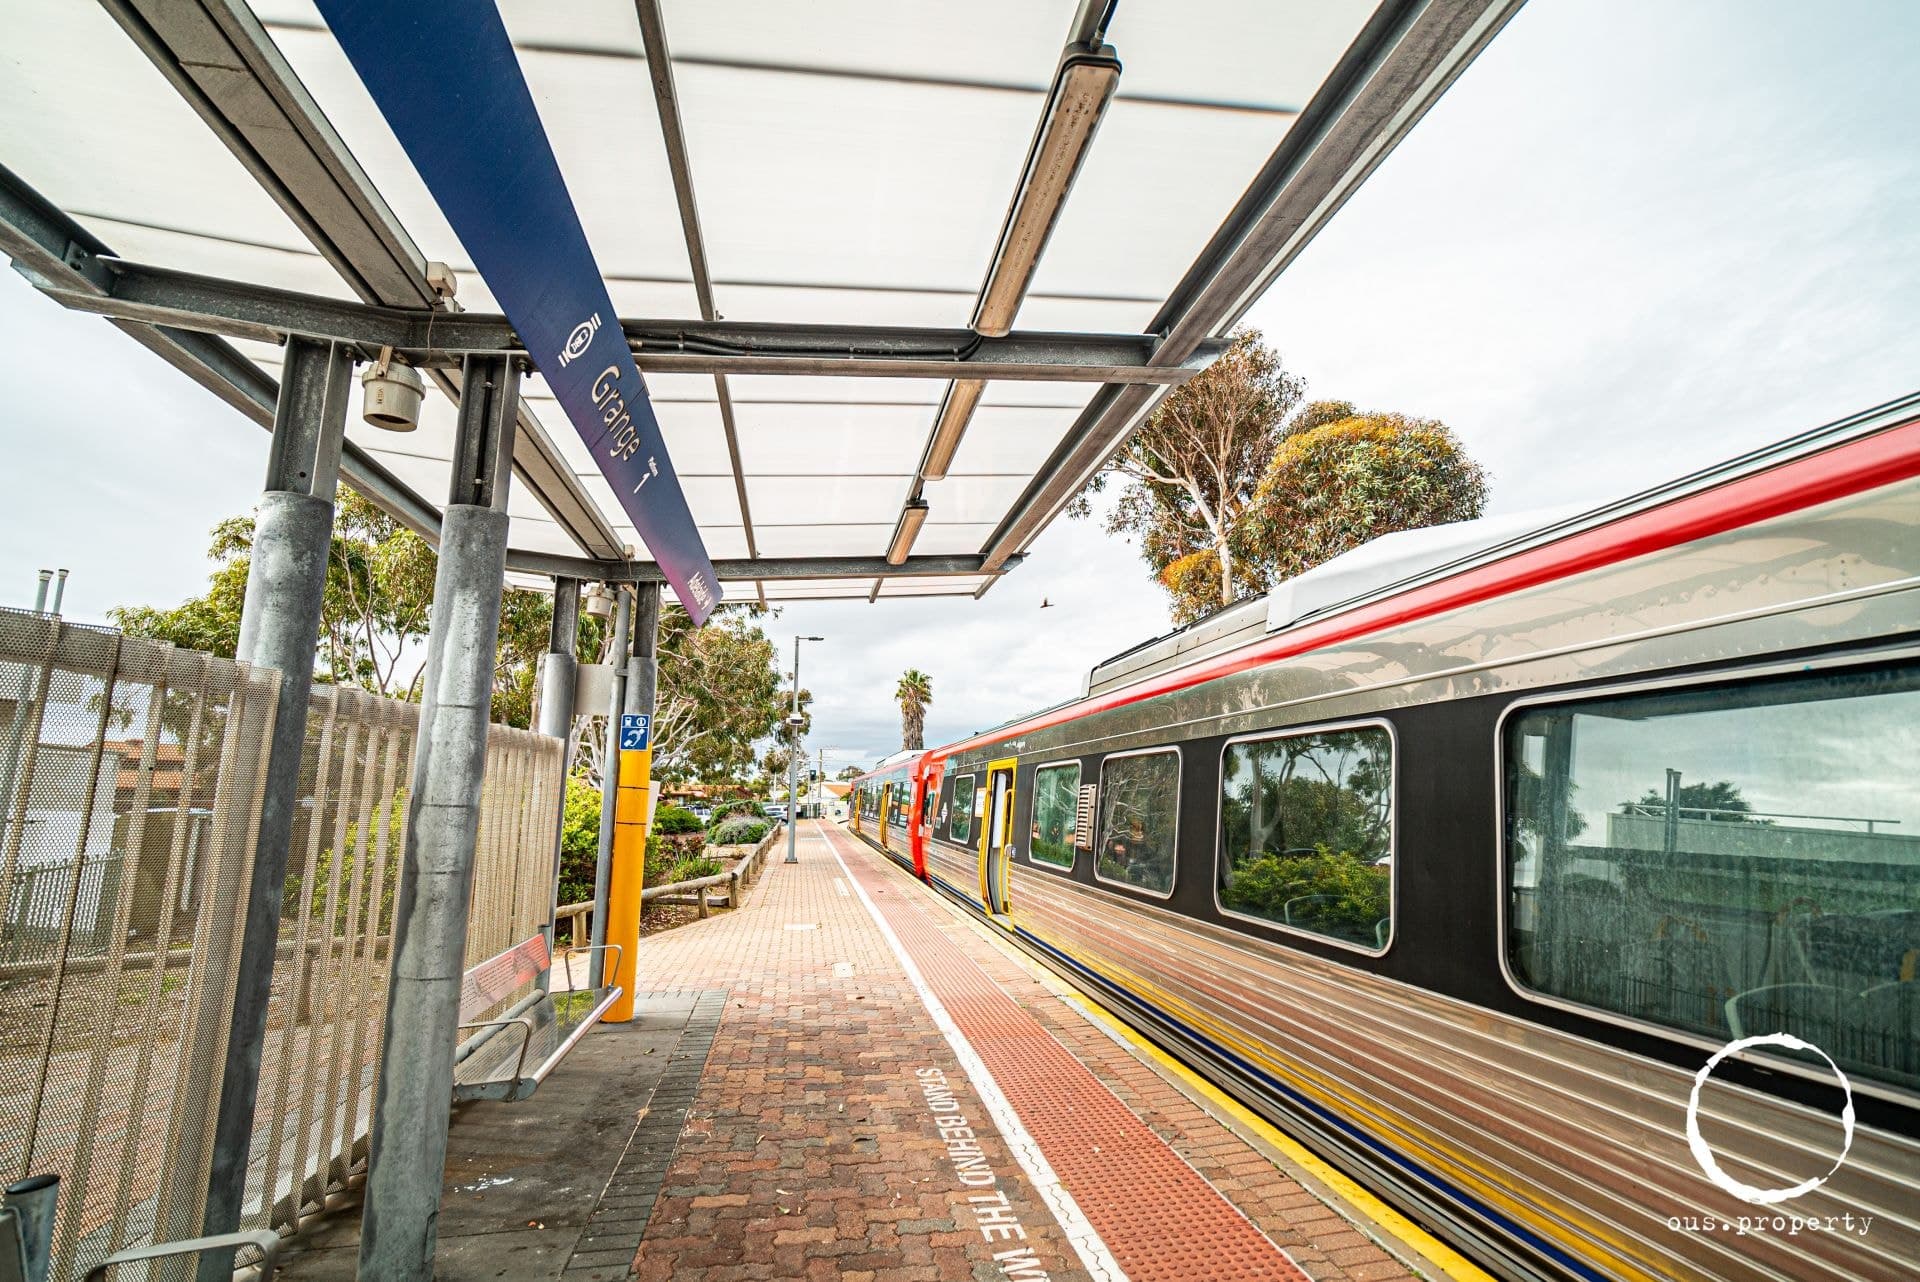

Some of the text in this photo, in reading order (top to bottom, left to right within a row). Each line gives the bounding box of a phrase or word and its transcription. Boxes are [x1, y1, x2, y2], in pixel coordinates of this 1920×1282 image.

[591, 365, 640, 462] Grange
[633, 472, 650, 494] 1
[915, 1068, 1051, 1282] STAND BEHIND THE W
